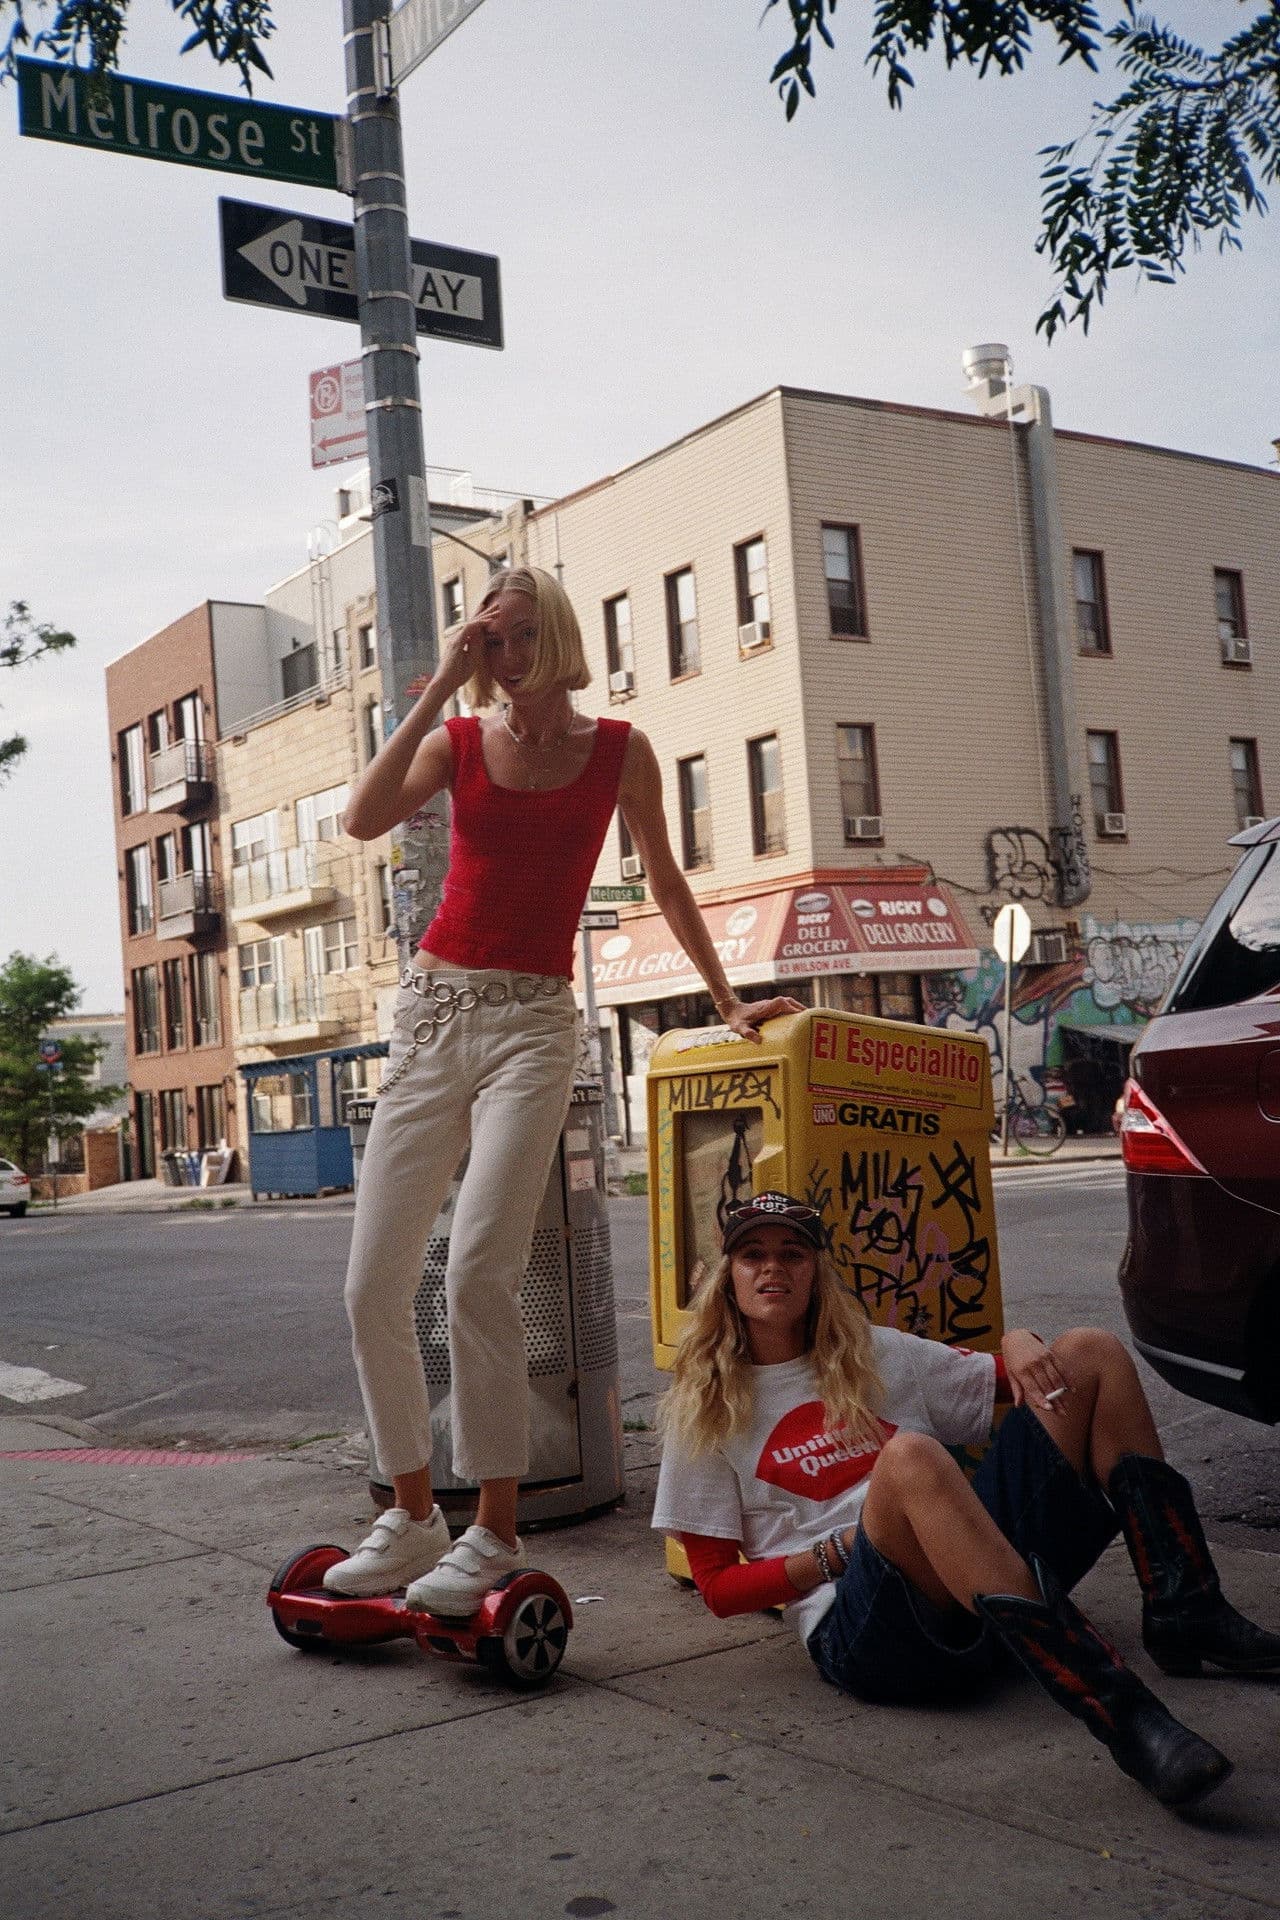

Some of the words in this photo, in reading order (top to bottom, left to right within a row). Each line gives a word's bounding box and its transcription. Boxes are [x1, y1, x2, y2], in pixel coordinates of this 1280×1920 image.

[40, 71, 267, 167] Melrose
[289, 119, 321, 156] St
[269, 239, 348, 288] ONE
[411, 268, 466, 311] AY
[592, 887, 633, 900] Melrose
[878, 900, 923, 916] RICKY
[797, 912, 831, 925] RICKY
[861, 923, 896, 945] DELI
[894, 920, 957, 944] GROCERY
[782, 939, 849, 957] GROCERY
[798, 926, 831, 941] DELI
[639, 935, 755, 976] GRORY
[814, 1022, 838, 1061] El
[846, 1027, 980, 1084] Especialito
[838, 1102, 941, 1136] GRATIS
[800, 1440, 880, 1477] Queen
